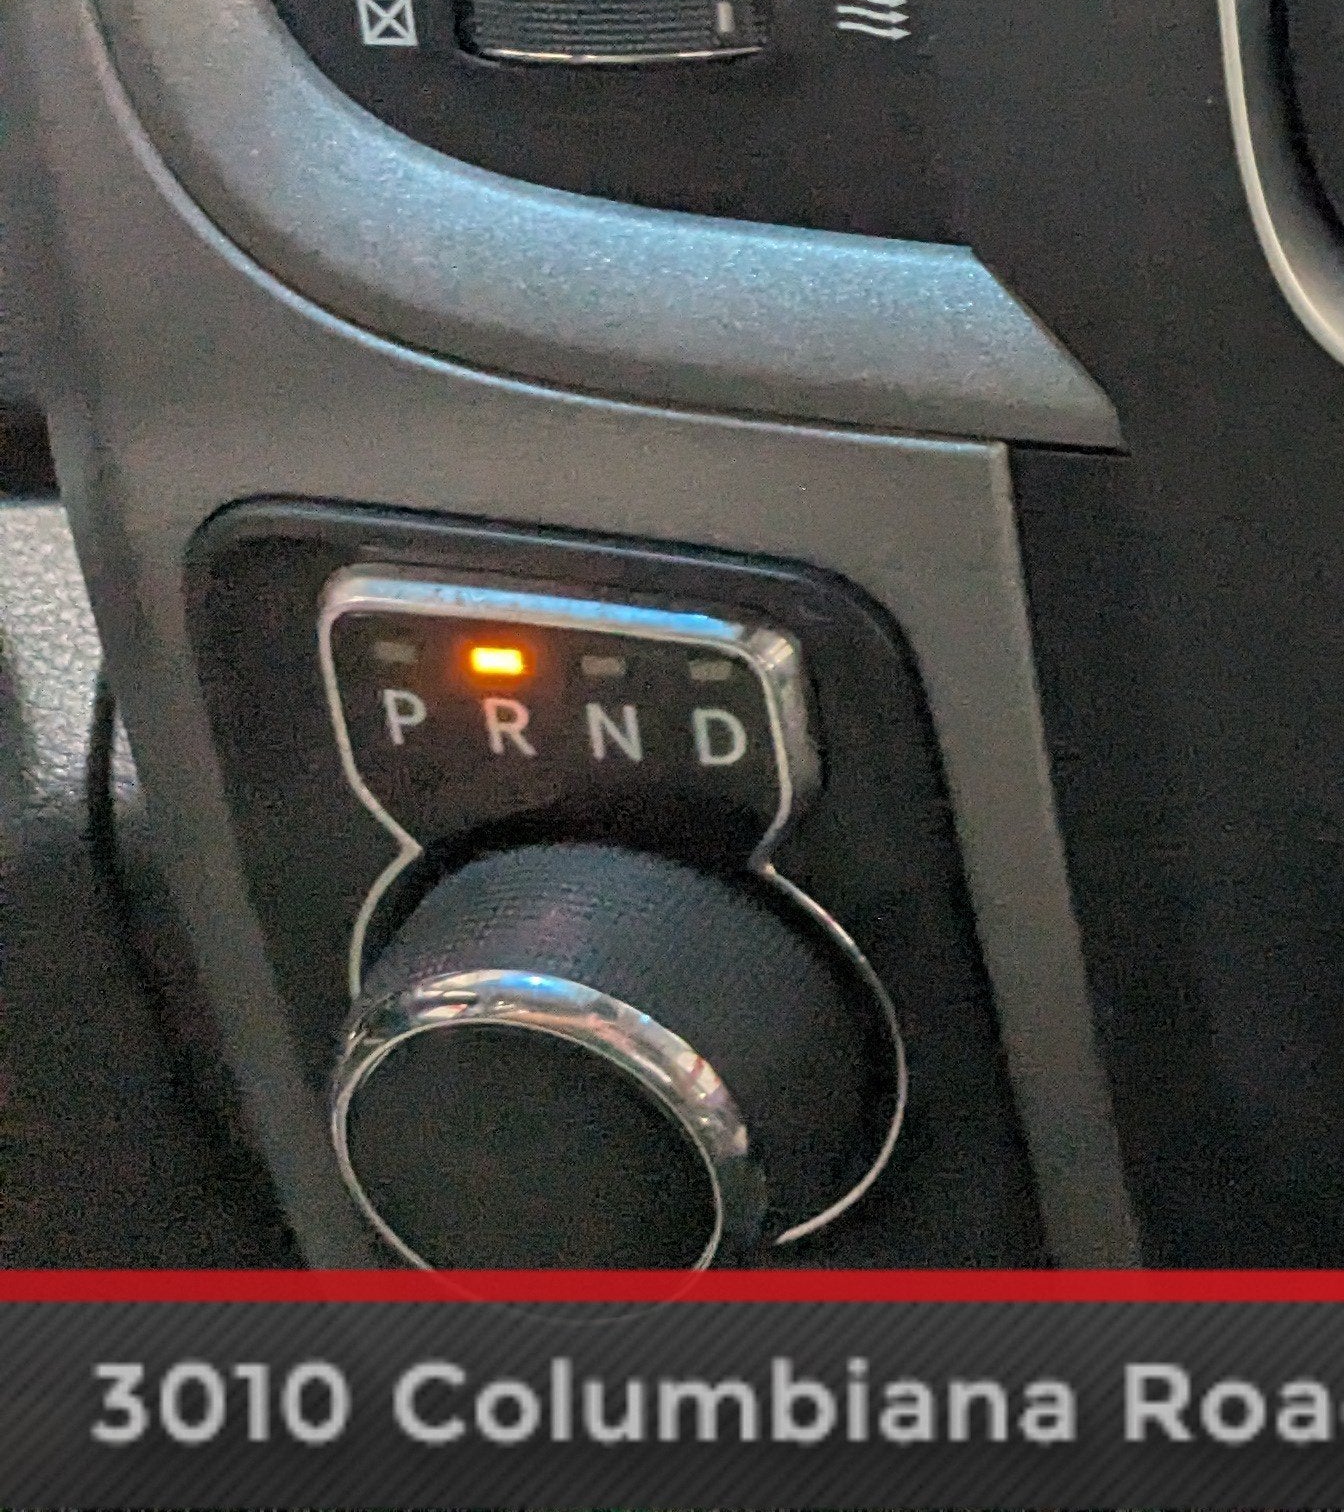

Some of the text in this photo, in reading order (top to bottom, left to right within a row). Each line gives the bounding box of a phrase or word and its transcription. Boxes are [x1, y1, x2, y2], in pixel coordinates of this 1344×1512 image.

[382, 687, 748, 767] P R N D
